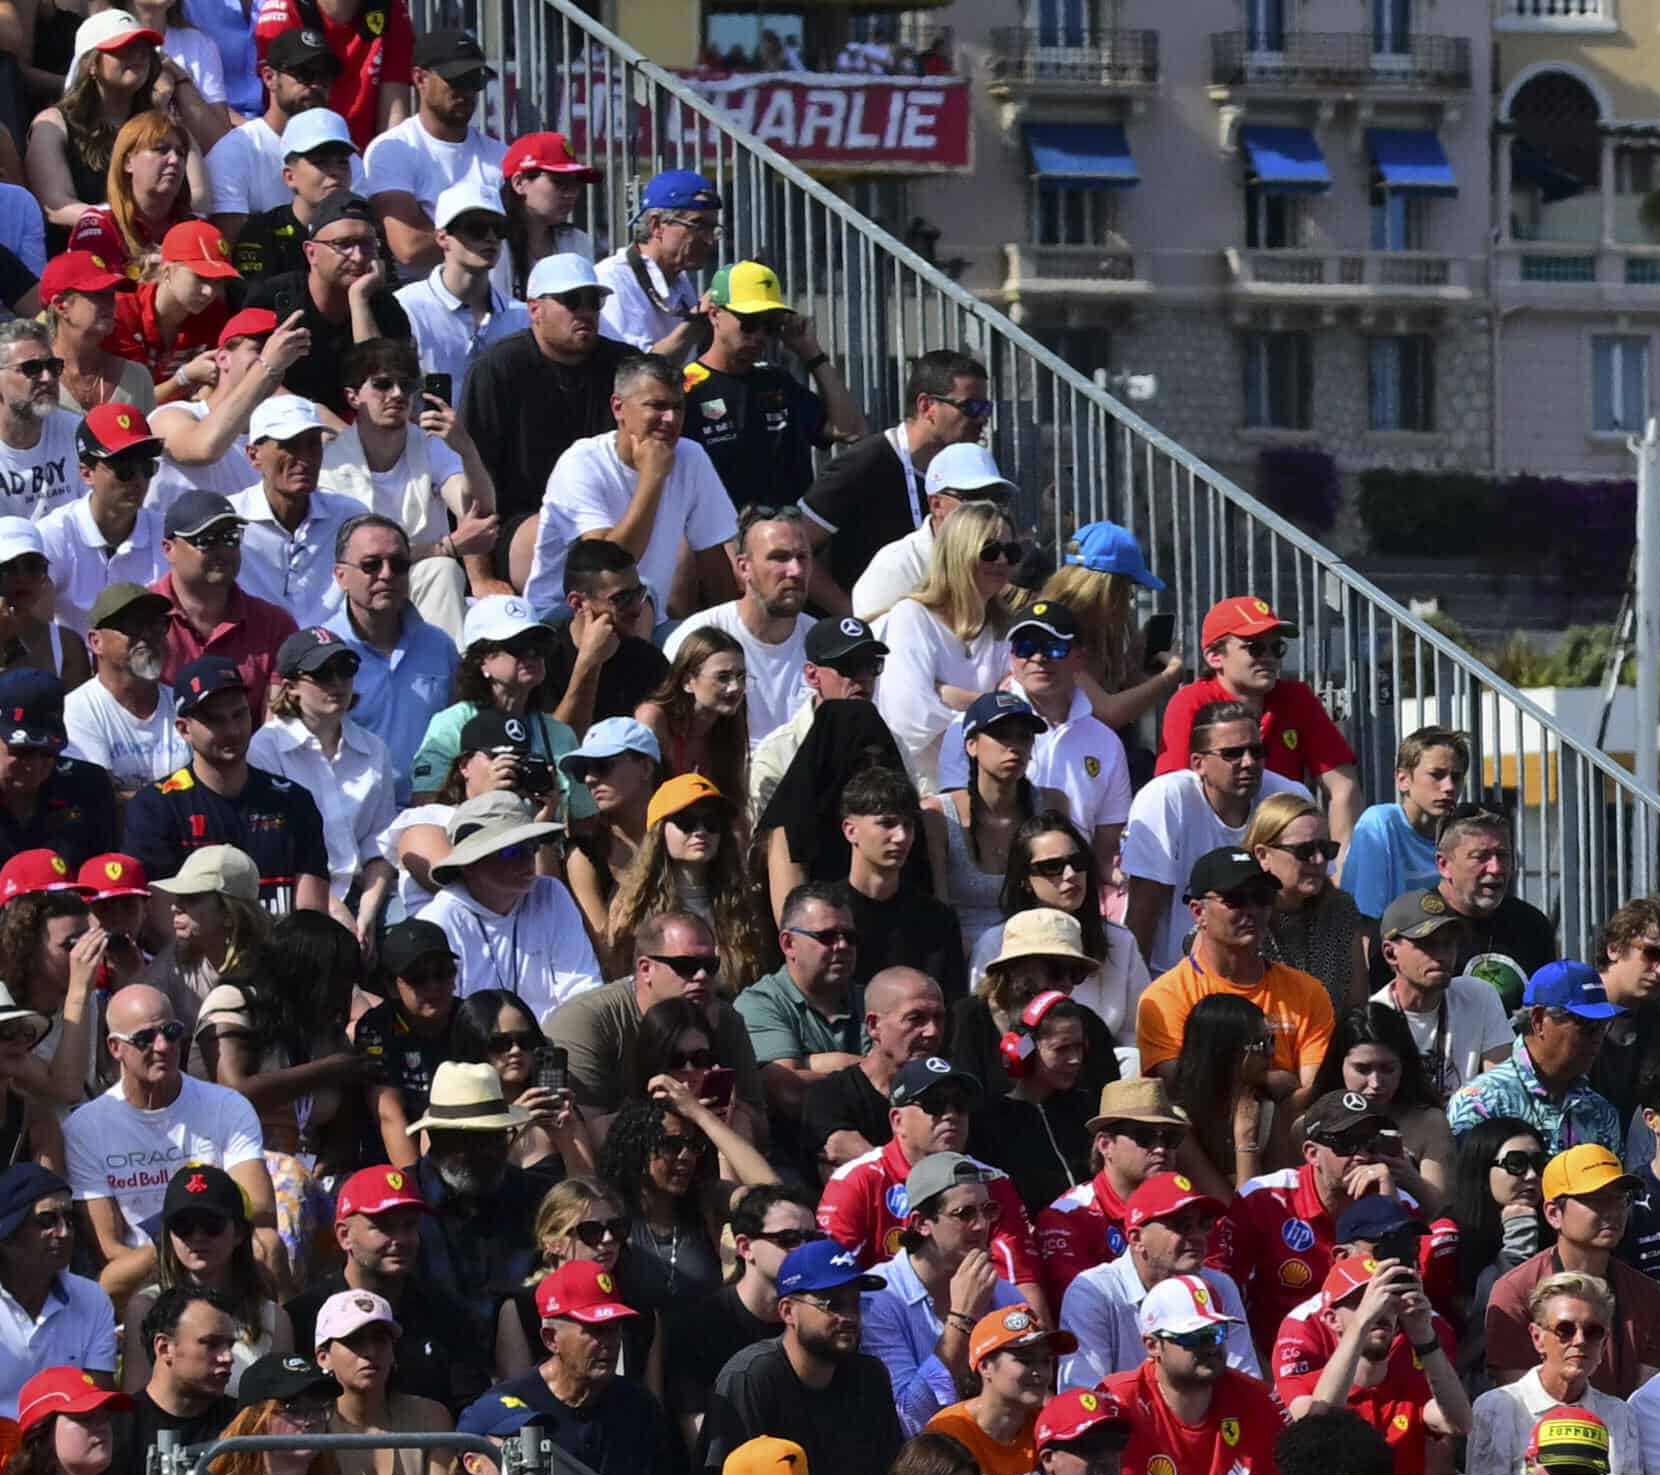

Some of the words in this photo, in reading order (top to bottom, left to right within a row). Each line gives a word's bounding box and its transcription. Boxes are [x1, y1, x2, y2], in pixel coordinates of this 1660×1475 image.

[32, 456, 67, 493] BOY
[107, 1172, 138, 1190] Red
[139, 1170, 169, 1188] Bull
[1286, 1218, 1313, 1250] hp
